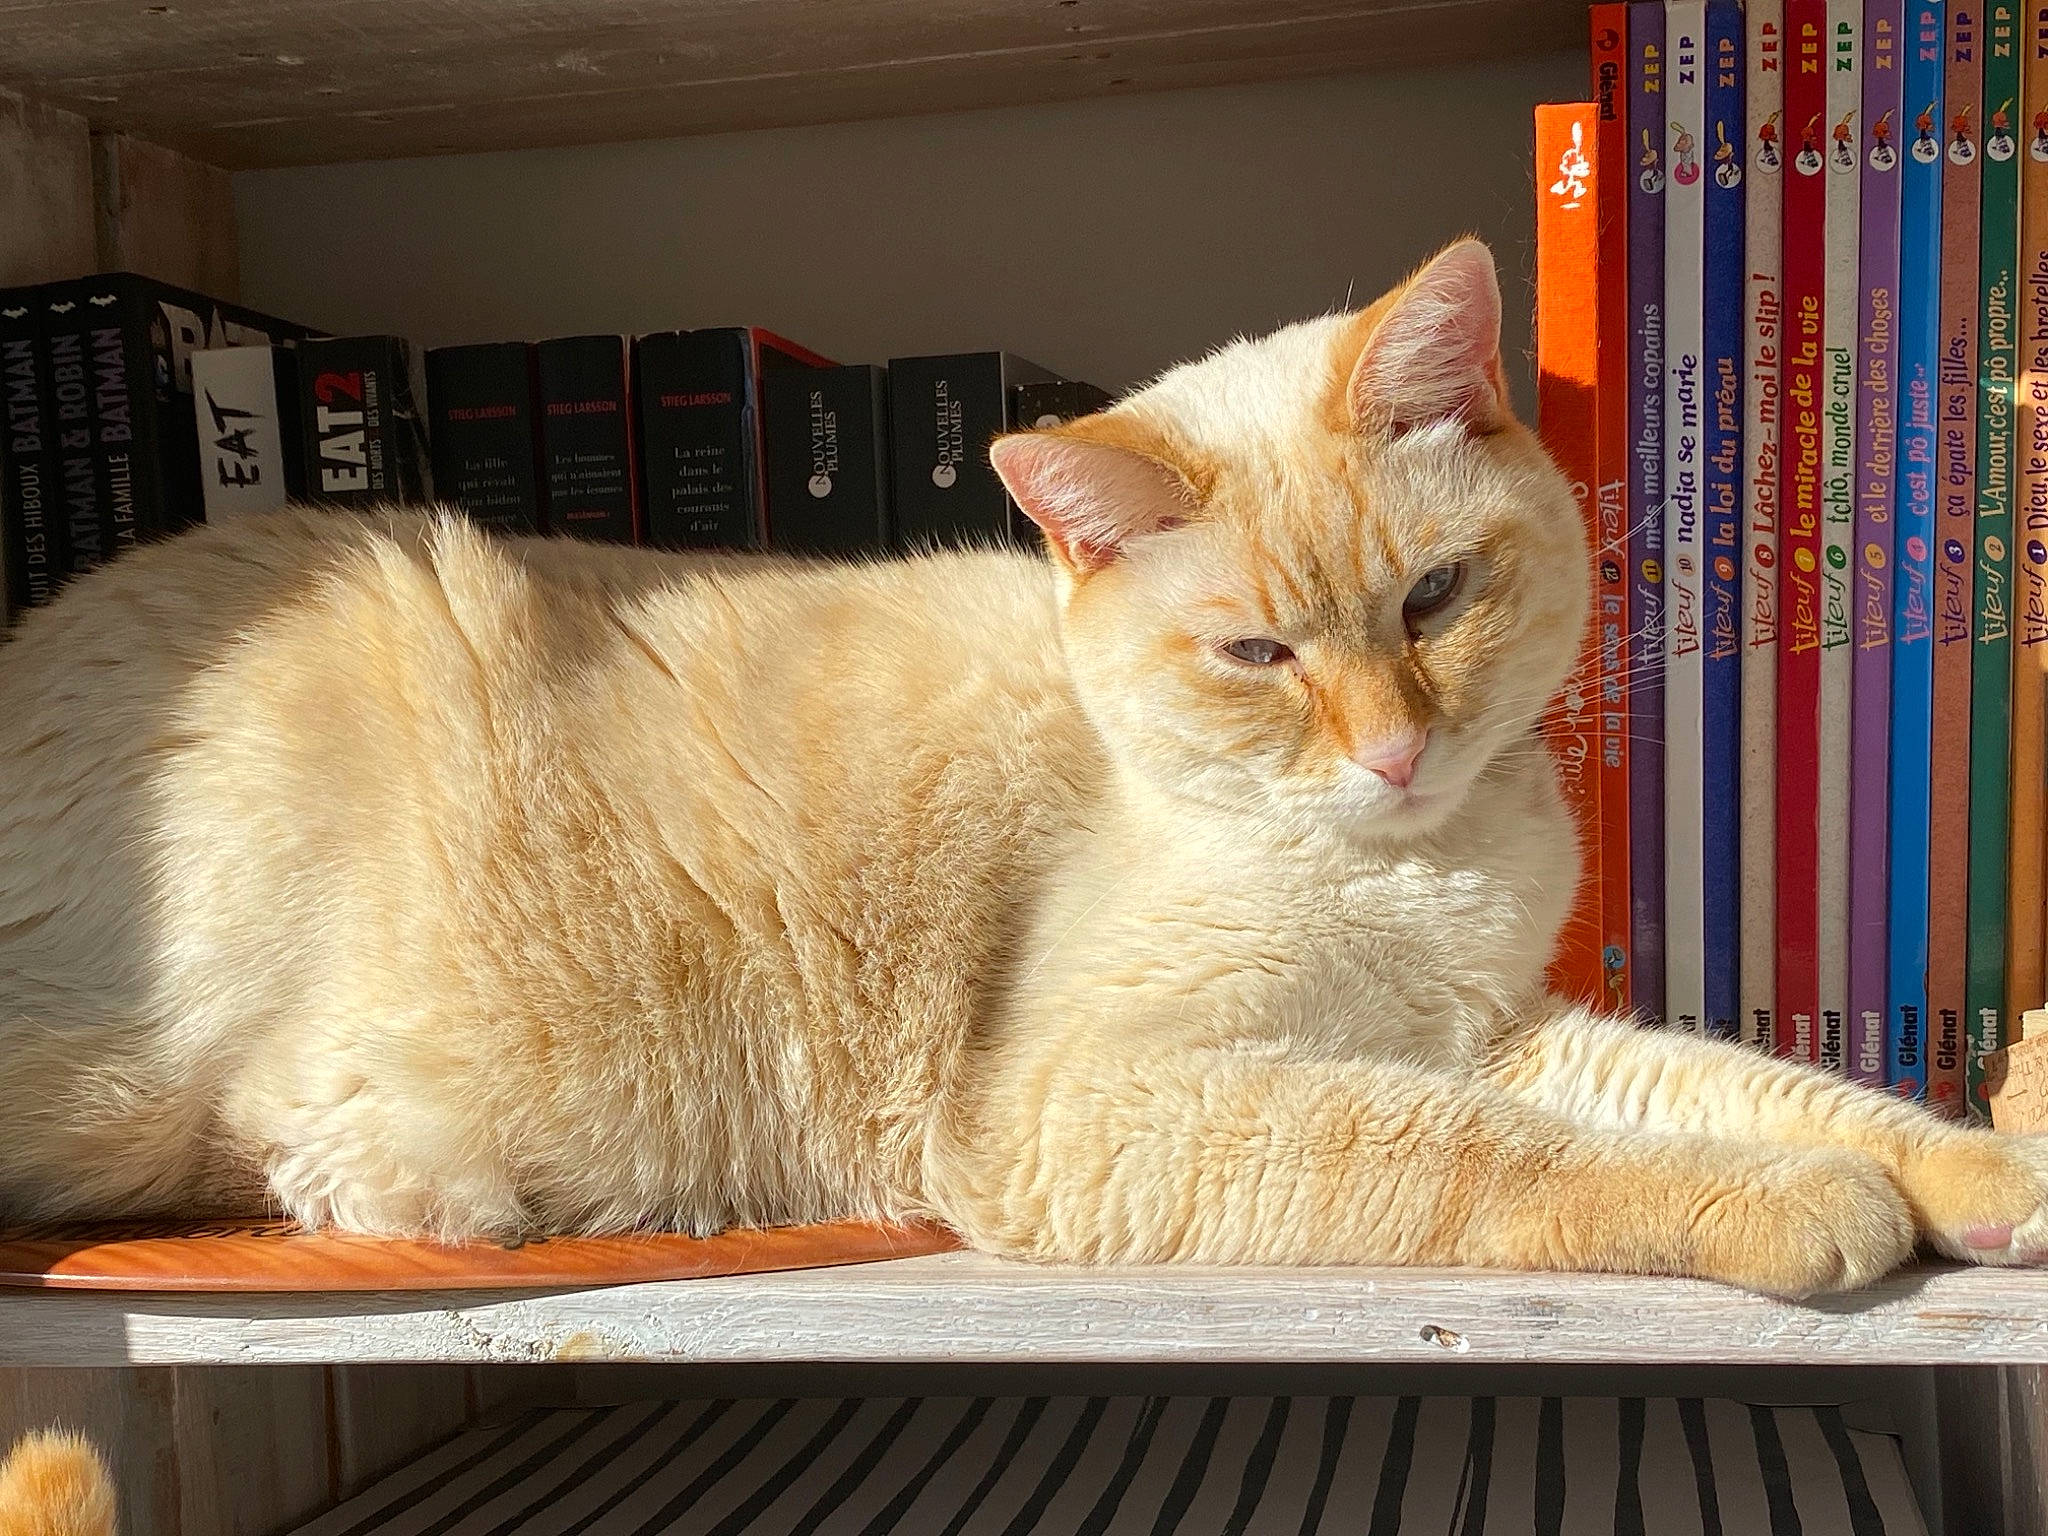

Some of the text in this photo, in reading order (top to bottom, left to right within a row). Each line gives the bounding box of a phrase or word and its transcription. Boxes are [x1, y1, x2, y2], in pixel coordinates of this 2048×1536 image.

[1762, 22, 1777, 72] ZEP
[1801, 22, 1818, 74] ZEP
[1836, 22, 1852, 72] ZEP
[1875, 18, 1892, 70] ZEP
[1919, 11, 1936, 62] ZEP
[1956, 12, 1972, 62] ZEP
[1994, 6, 2010, 58] ZEP
[1644, 44, 1660, 93] ZEP
[1680, 36, 1694, 84] ZEP
[1719, 38, 1735, 88] ZEP
[1600, 61, 1618, 121] Glénat
[1755, 289, 1780, 339] slip
[1798, 295, 1819, 335] vie
[1863, 287, 1893, 353] choses
[1986, 269, 2014, 351] propre...
[2029, 250, 2048, 342] bretelles
[1638, 303, 1664, 389] copains
[1755, 345, 1777, 369] le
[1791, 341, 1818, 366] la
[1825, 346, 1851, 396] cruel
[1942, 317, 1973, 387] filles...
[1983, 356, 2014, 382] pô
[2029, 347, 2048, 371] les
[2, 338, 42, 453] BATMAN
[51, 332, 87, 420] ROBIN
[90, 327, 133, 443] BATMAN
[363, 370, 378, 408] VIVANTS
[1672, 354, 1698, 428] marie
[1714, 357, 1740, 433] préau
[1790, 373, 1813, 408] de
[1862, 358, 1889, 391] des
[2029, 381, 2048, 401] et
[366, 409, 380, 427] DES
[546, 400, 617, 416] STIEG LARSSON
[660, 392, 732, 408] STIEG LARSSON
[1942, 395, 1968, 422] les
[1984, 385, 2009, 428] c'est
[60, 429, 90, 449] &
[204, 387, 264, 488] EAT
[674, 445, 725, 458] La reine
[810, 390, 827, 486] NOUVELLES
[823, 410, 838, 473] PLUMES
[935, 379, 953, 476] NOUVELLES
[949, 400, 964, 463] PLUMES
[1635, 394, 1660, 496] meilleurs
[1677, 436, 1696, 463] se
[1825, 401, 1851, 467] monde
[1865, 398, 1892, 478] derrière
[1904, 436, 1933, 464] pô
[2033, 407, 2048, 453] sexe
[679, 463, 724, 477] dans le
[1711, 439, 1737, 474] du
[1753, 374, 1779, 535] Lâchez-moi
[1794, 411, 1818, 509] miracle
[1942, 430, 1973, 486] épate
[1979, 431, 2010, 518] L'Amour,
[2025, 457, 2047, 476] le
[20, 463, 44, 528] HIBOUX
[108, 453, 133, 522] FAMILLE
[671, 483, 709, 500] palais
[1670, 471, 1698, 543] nadia
[1709, 483, 1735, 515] loi
[1823, 472, 1853, 523] tchô,
[1861, 481, 1888, 499] le
[1905, 471, 1929, 516] c'est
[1946, 495, 1971, 517] ça
[1599, 478, 1625, 560] titeuf
[1643, 504, 1661, 551] mes
[1712, 522, 1735, 546] la
[1790, 513, 1816, 538] le
[1864, 504, 1888, 524] et
[25, 533, 46, 564] DES
[1601, 594, 1624, 615] le
[1672, 578, 1700, 659] titeuf
[1710, 580, 1738, 662] titeuf
[1749, 567, 1778, 650] titeuf
[1789, 570, 1820, 656] titeuf
[1822, 567, 1850, 652] titeuf
[1860, 567, 1889, 653] titeuf
[1900, 559, 1930, 646] titeuf
[1939, 562, 1968, 647] titeuf
[1978, 559, 2009, 646] titeuf
[2021, 563, 2048, 649] titeuf
[1604, 677, 1623, 705] de
[1603, 711, 1624, 732] la
[1604, 737, 1624, 769] vie
[1752, 1009, 1770, 1047] énat
[1790, 1012, 1812, 1062] lénat
[1822, 1009, 1841, 1071] Glénat
[1859, 1010, 1881, 1073] Glénat
[1897, 1004, 1919, 1067] Glénat
[1936, 1008, 1957, 1070] Glénat
